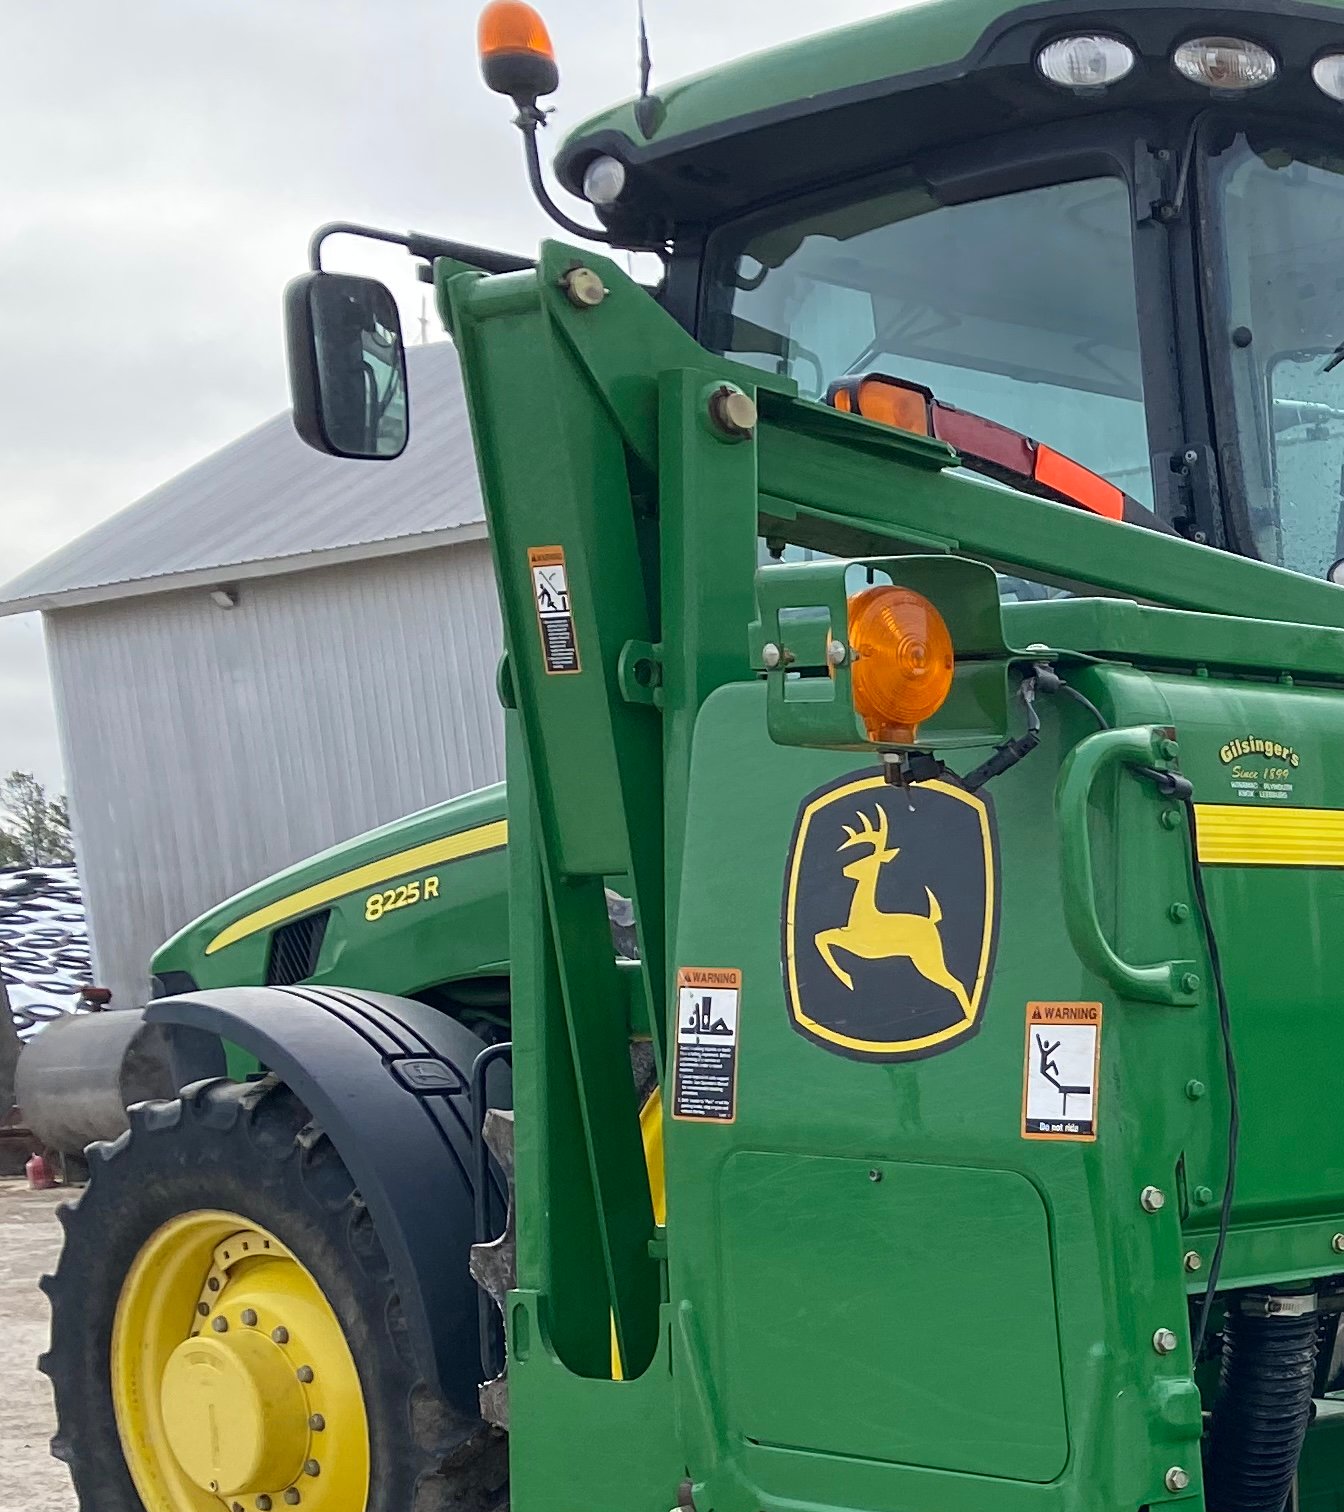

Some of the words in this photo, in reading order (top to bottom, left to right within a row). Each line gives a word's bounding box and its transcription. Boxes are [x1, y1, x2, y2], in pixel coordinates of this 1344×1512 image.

[1219, 735, 1300, 767] Gilsinger's
[1231, 765, 1258, 779] Since
[1263, 767, 1289, 780] 1899
[693, 972, 737, 984] WARNING
[1044, 1007, 1097, 1020] WARNING
[1040, 1122, 1050, 1131] Do
[1051, 1123, 1063, 1132] not
[1065, 1123, 1079, 1133] ride
